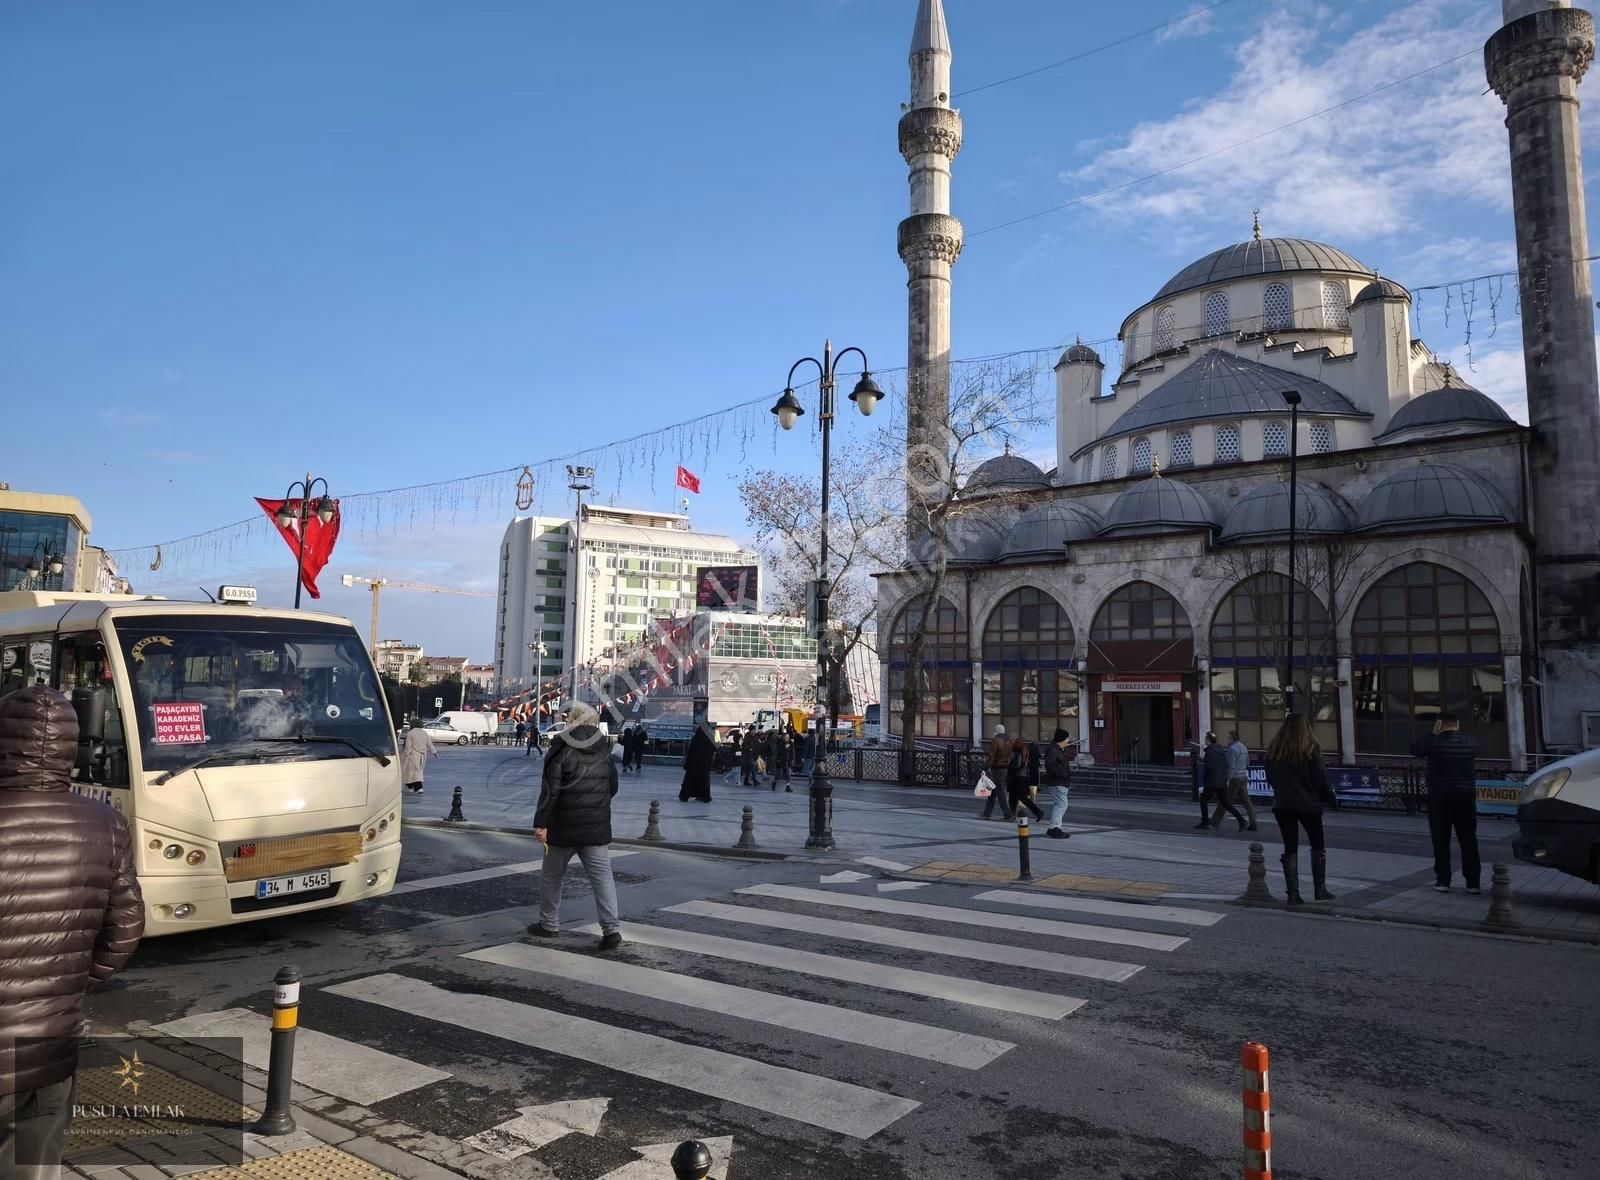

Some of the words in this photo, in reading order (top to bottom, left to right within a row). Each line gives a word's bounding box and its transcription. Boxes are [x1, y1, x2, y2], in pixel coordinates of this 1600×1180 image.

[225, 589, 256, 599] G.O.PAŞA
[157, 714, 200, 723] KARADENİZ
[158, 725, 173, 733] 500
[174, 724, 201, 732] EVLER
[159, 733, 202, 743] G.O.PAŞA
[267, 881, 280, 894] 34
[287, 879, 293, 891] M
[302, 873, 327, 888] 4545
